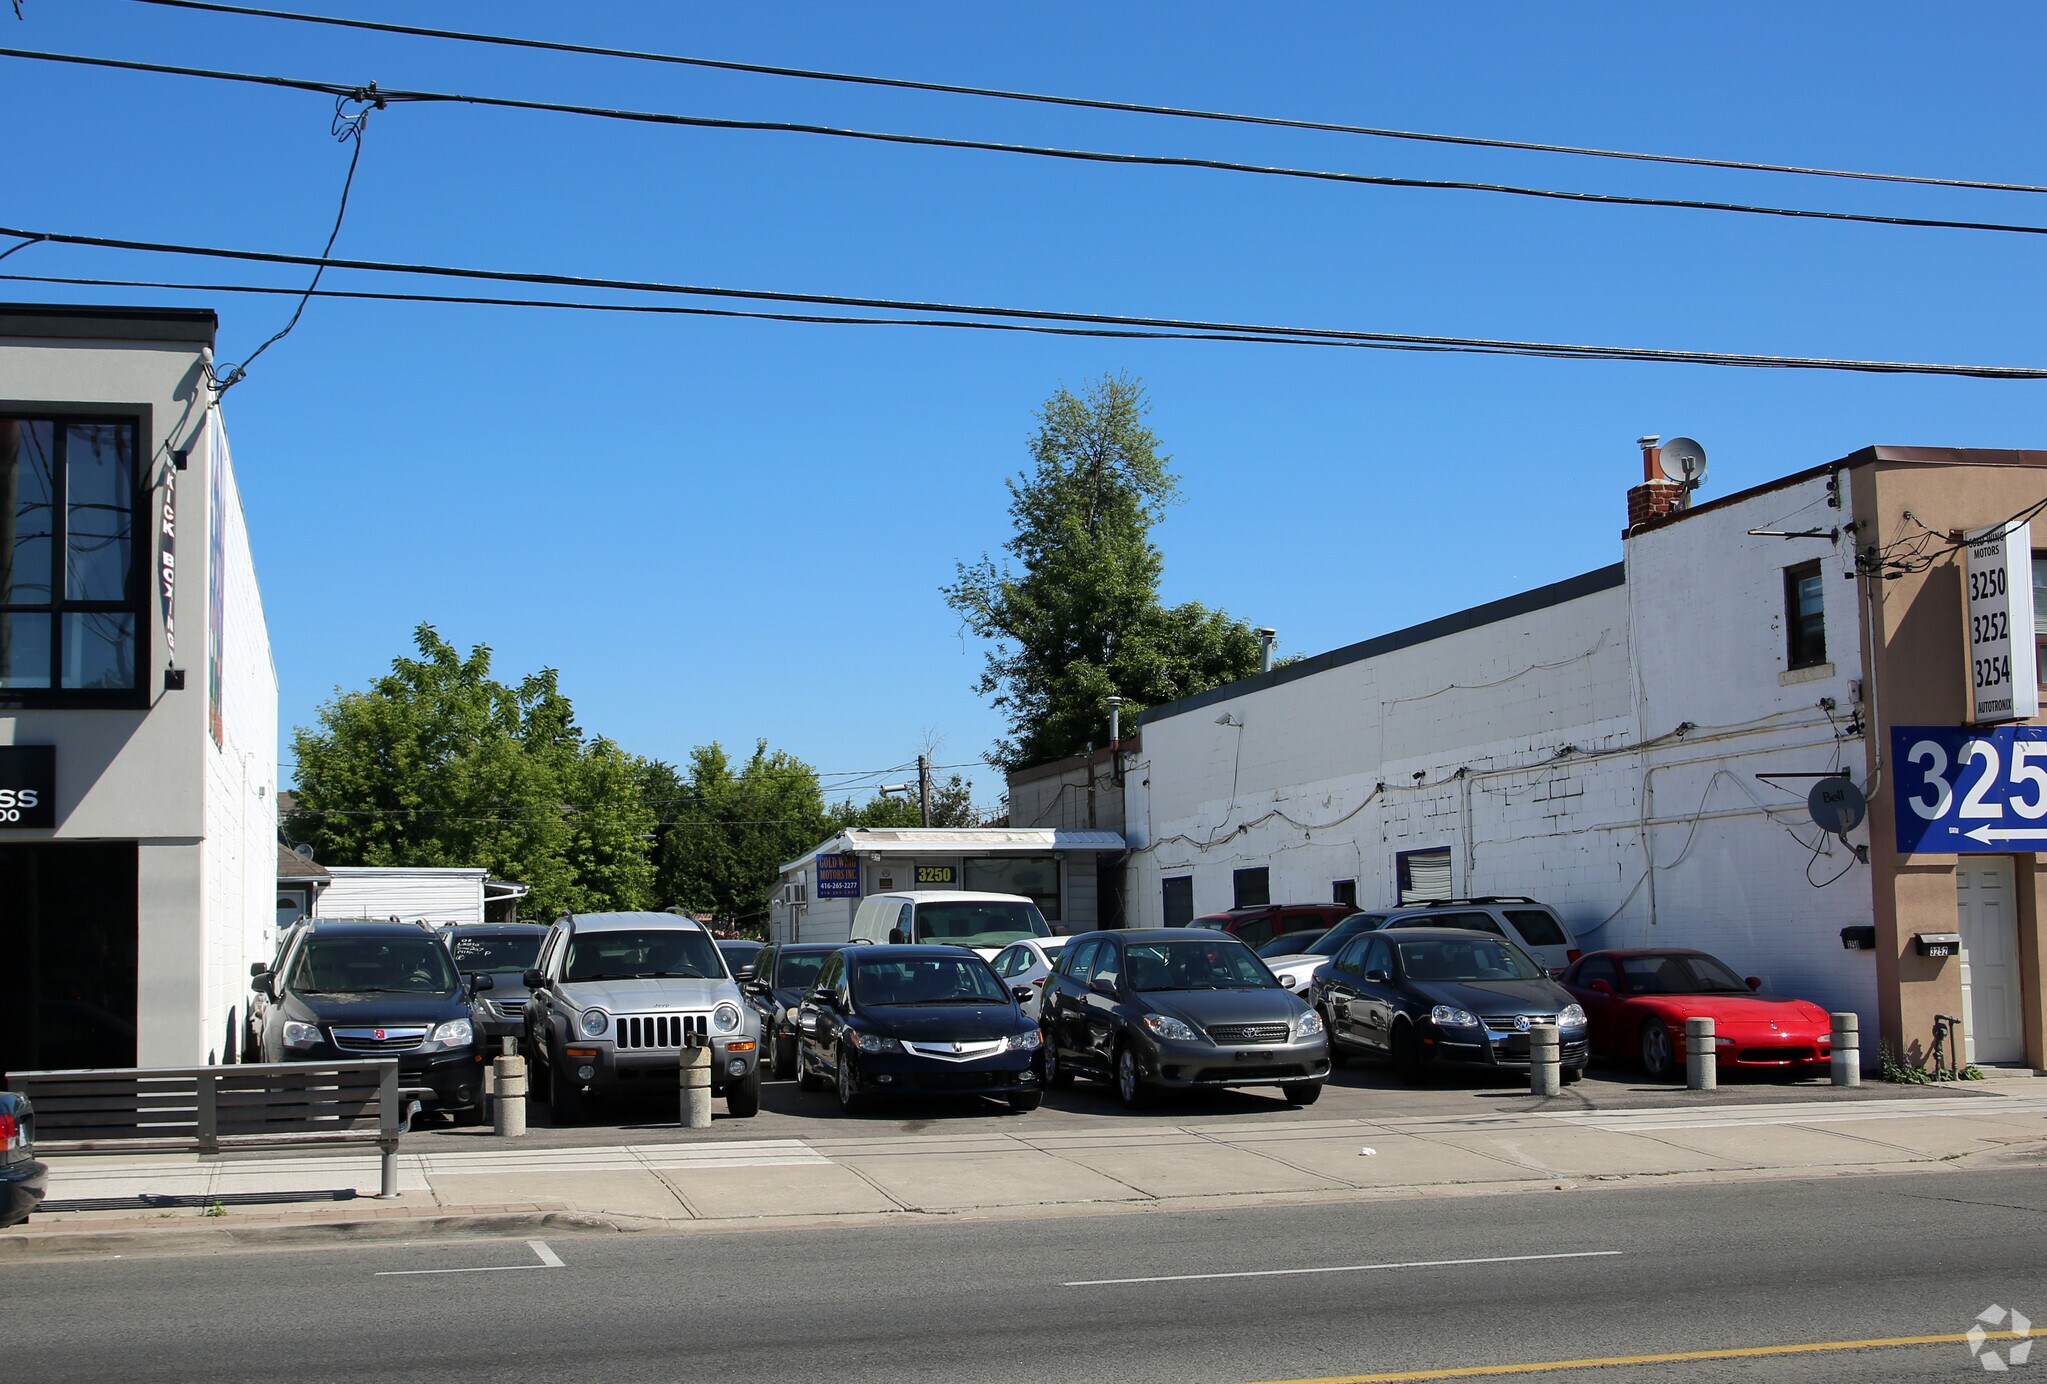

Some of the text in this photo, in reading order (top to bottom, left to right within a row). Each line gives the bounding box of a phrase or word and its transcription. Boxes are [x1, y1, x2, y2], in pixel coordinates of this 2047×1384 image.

[163, 472, 175, 538] KICK
[1974, 545, 2000, 559] MOTORS
[1971, 567, 2006, 601] 3250
[1974, 611, 2008, 644] 3252
[1976, 655, 2010, 688] 3254
[1978, 698, 2012, 714] AUTOTRONIX
[1823, 790, 1845, 803] Bell
[820, 856, 837, 868] GOLD
[820, 869, 845, 880] MOTORS
[918, 867, 951, 882] 3250
[1930, 946, 1949, 956] 3252
